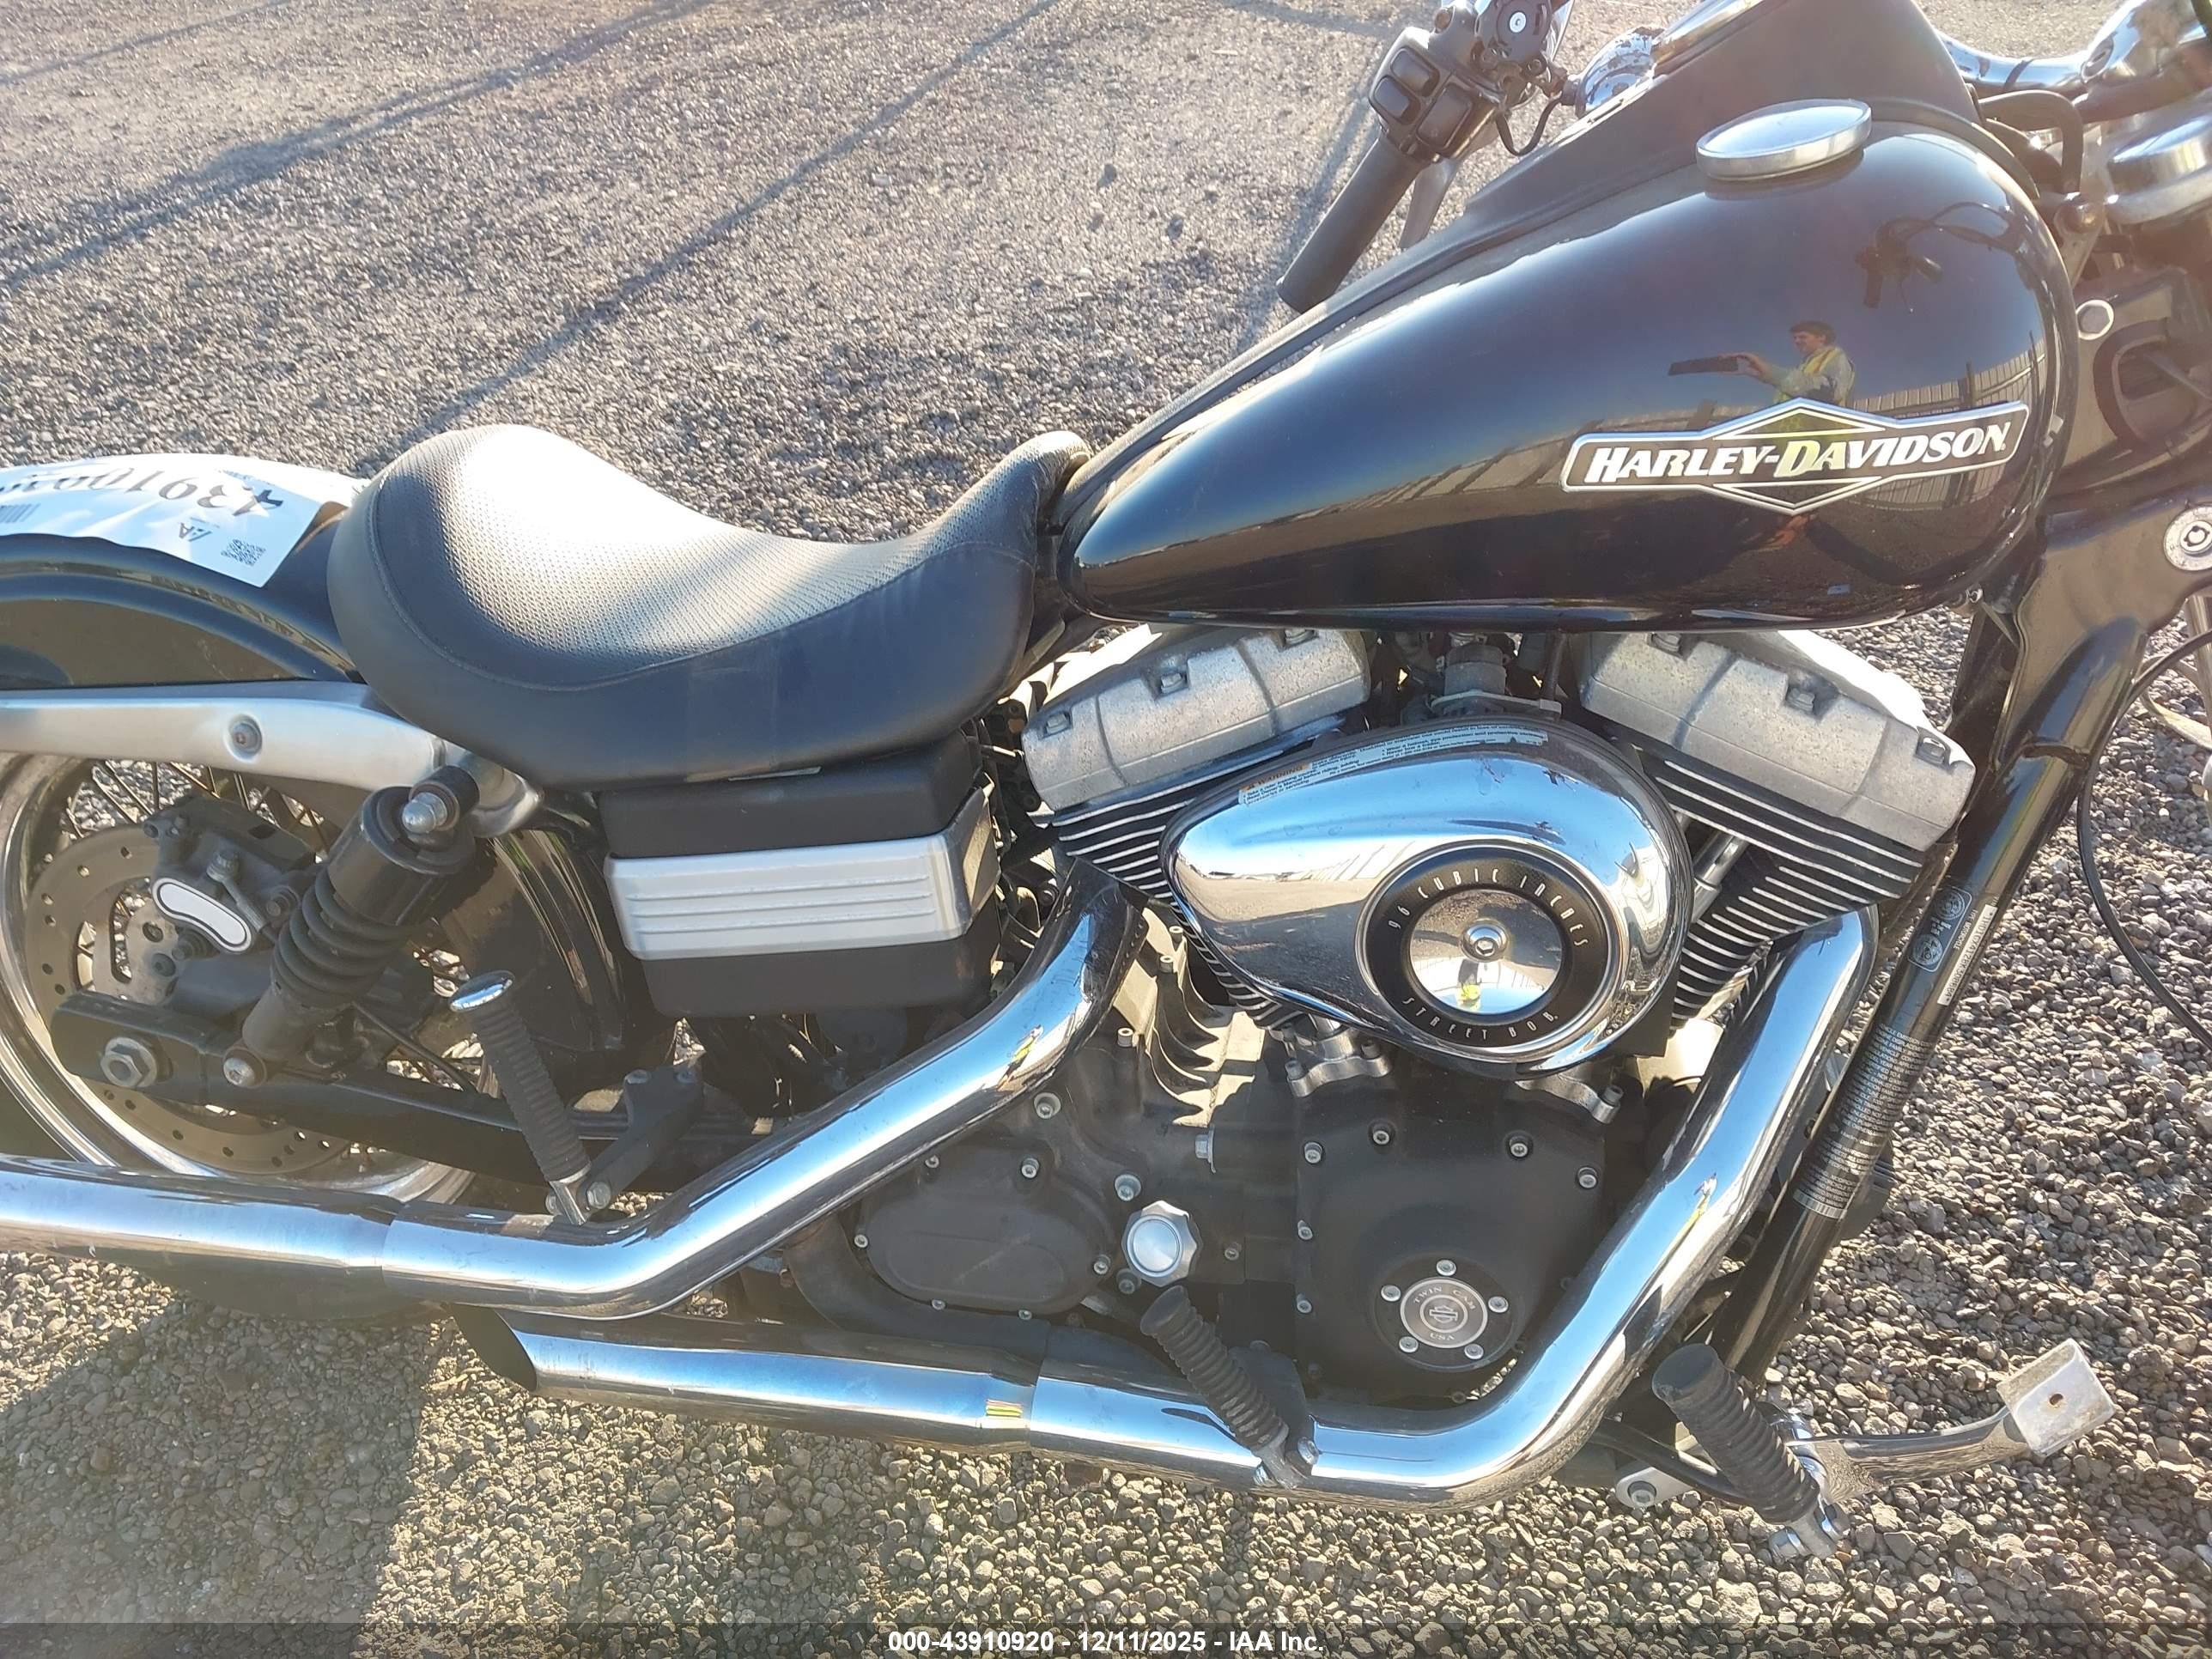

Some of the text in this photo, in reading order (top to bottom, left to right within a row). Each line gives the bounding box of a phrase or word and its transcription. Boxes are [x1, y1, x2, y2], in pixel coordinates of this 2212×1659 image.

[1584, 421, 2008, 483] HARLEY-DAVIDSON
[1388, 868, 1589, 948] 96 CUBIC INCHES
[1402, 997, 1488, 1040] STREET
[1413, 1286, 1476, 1310] TWIN CAM
[1429, 1333, 1455, 1341] USA
